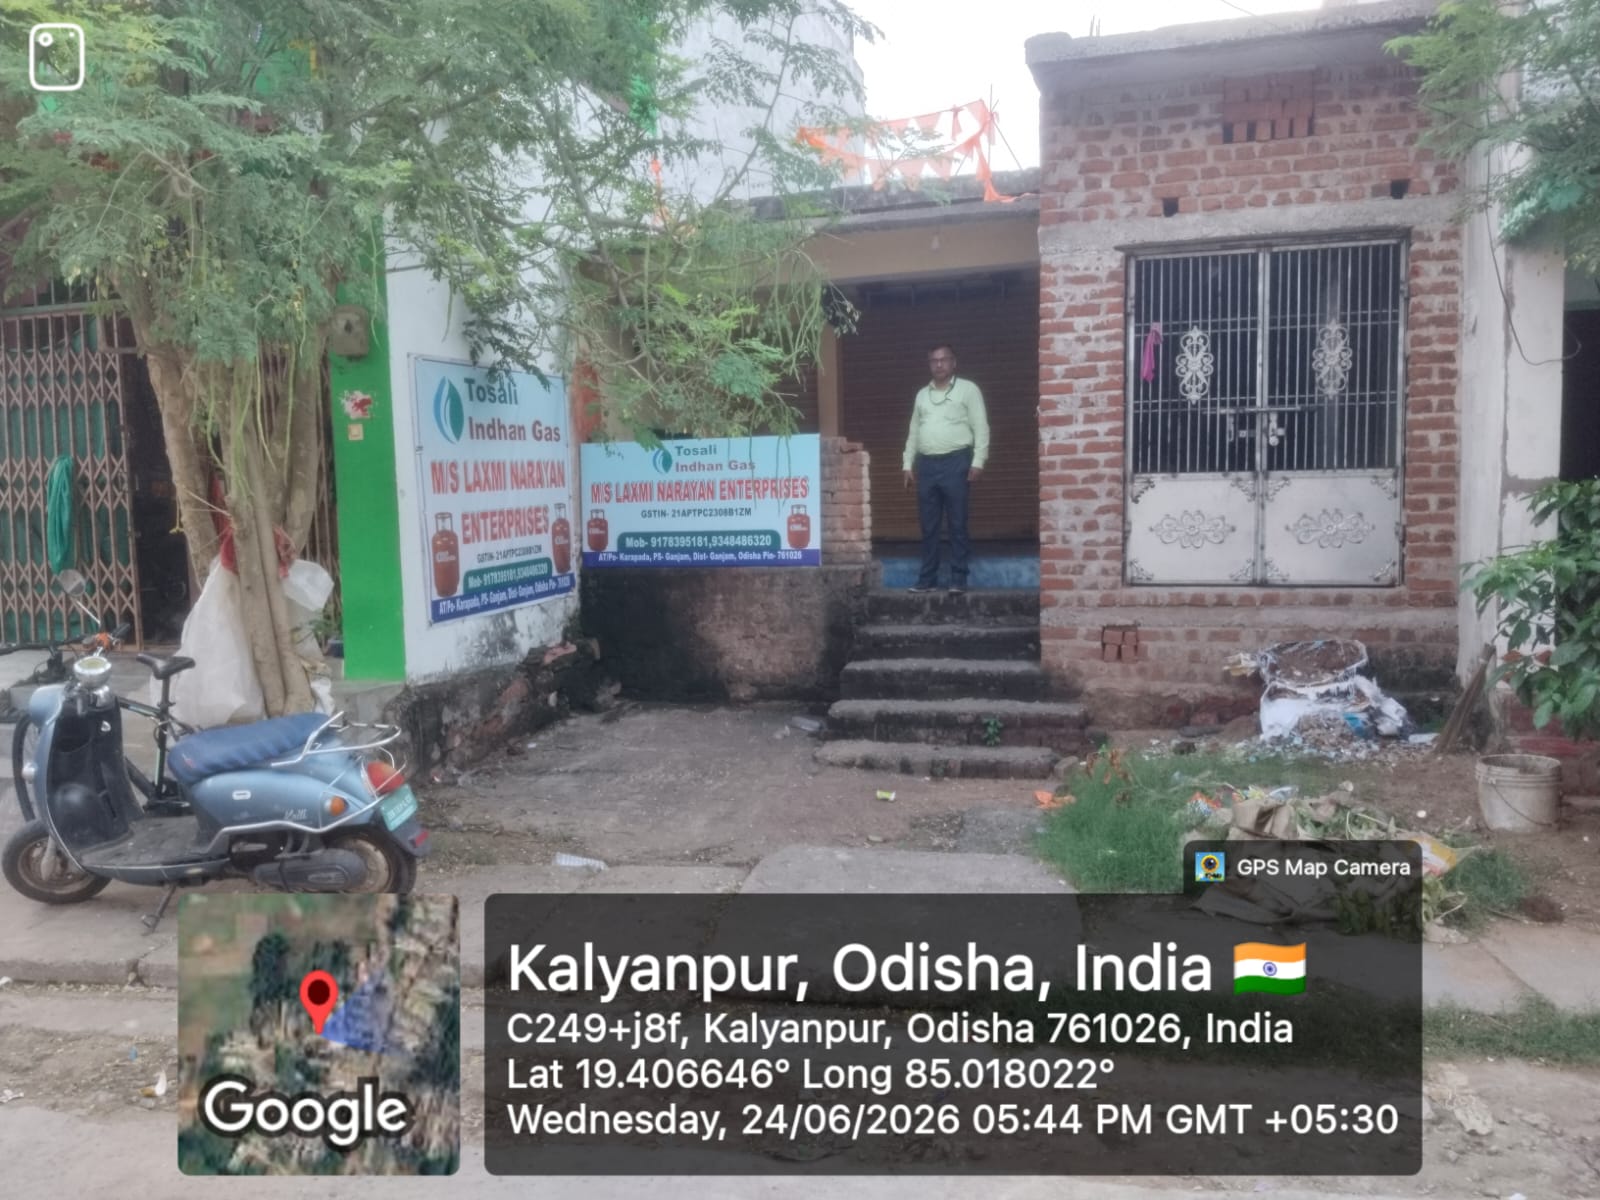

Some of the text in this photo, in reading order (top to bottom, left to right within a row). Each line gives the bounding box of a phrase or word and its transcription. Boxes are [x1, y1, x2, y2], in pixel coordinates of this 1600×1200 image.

[464, 377, 518, 405] Tosali
[468, 416, 561, 442] Indhan Gas
[675, 444, 717, 457] Tosali
[675, 459, 756, 473] Indhan Gas
[430, 460, 566, 494] M/S LAXMI NARAYAN
[591, 477, 809, 504] M/S LAXMI NARAYAN ENTERPRISES
[461, 504, 550, 544] ENTERPRISES
[640, 509, 670, 519] GSTIN-
[625, 537, 648, 548] Mob-
[738, 551, 762, 560] Odisha
